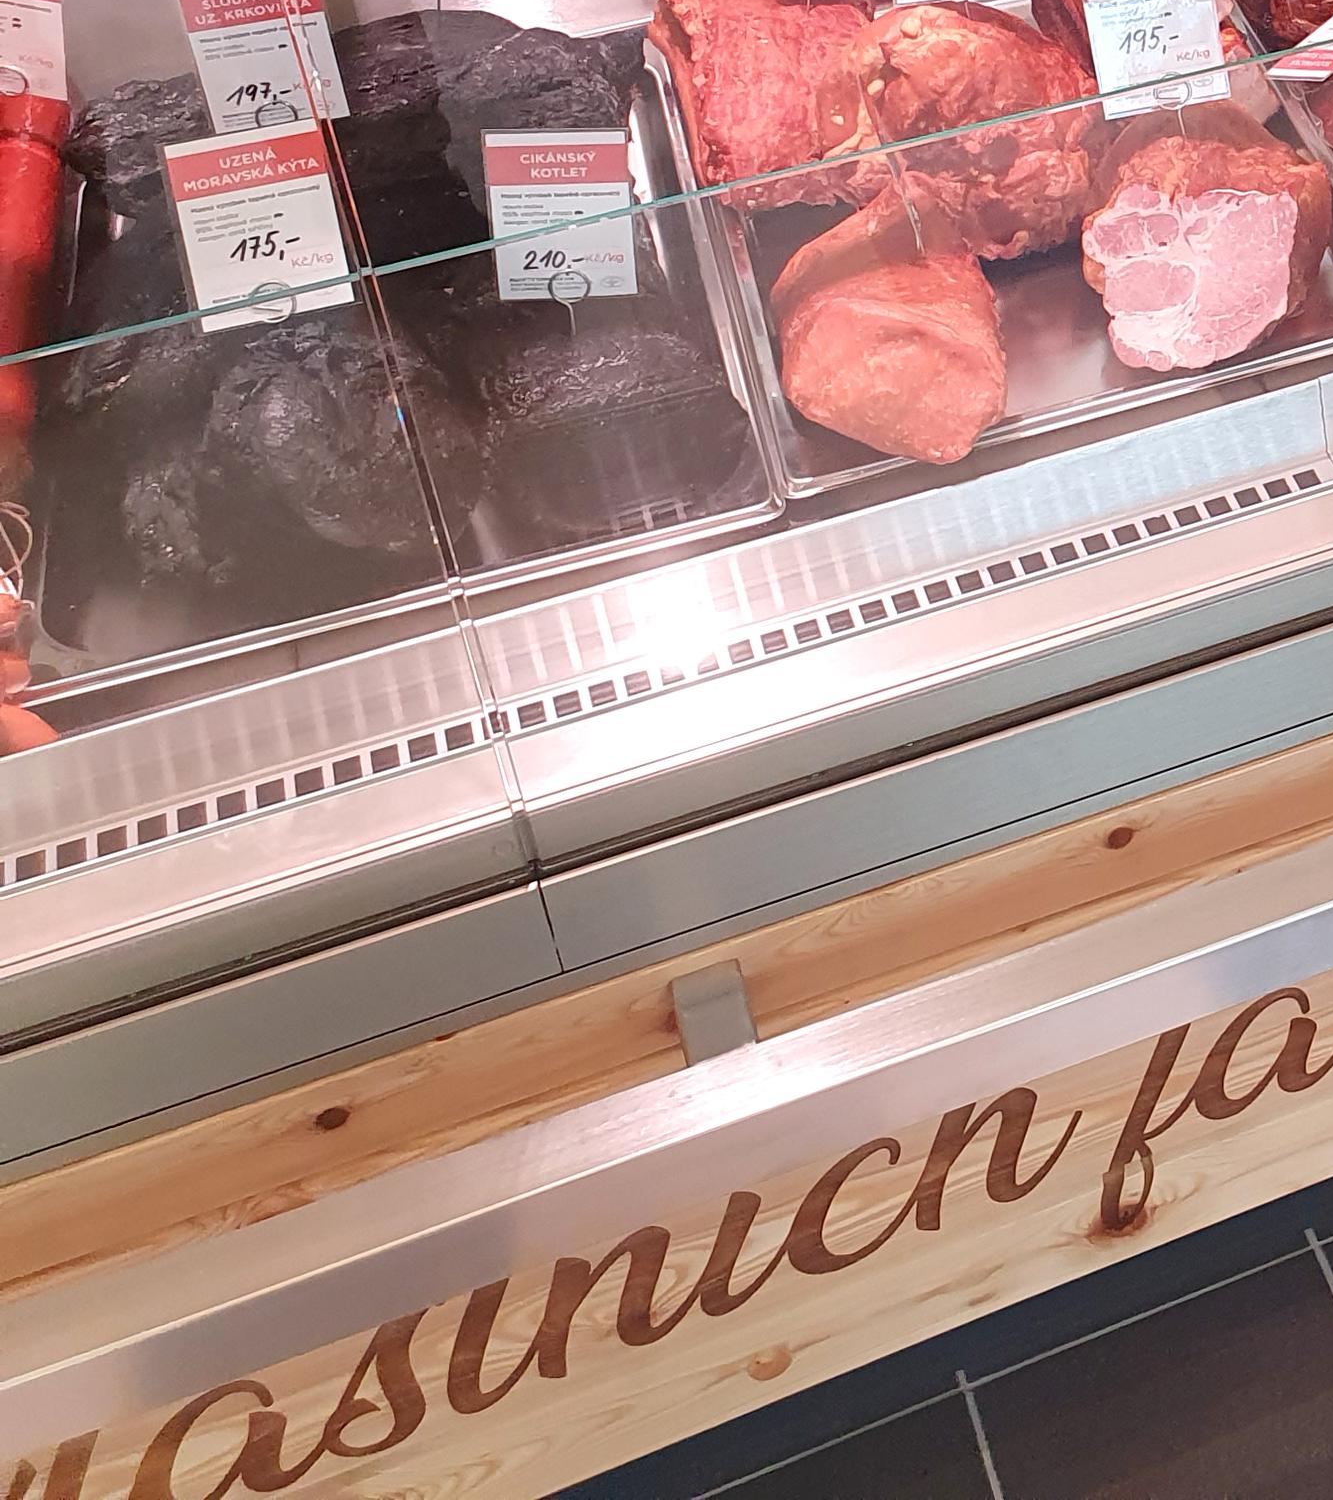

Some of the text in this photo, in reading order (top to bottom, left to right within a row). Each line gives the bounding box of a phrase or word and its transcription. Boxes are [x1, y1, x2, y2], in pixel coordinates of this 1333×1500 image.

[194, 12, 221, 26] UZ.
[1119, 25, 1180, 54] 195,-
[227, 81, 292, 106] 197,-
[219, 146, 278, 169] UZENÁ
[520, 150, 597, 165] CIKÁNSKÝ
[183, 157, 320, 192] MORAVSKÁ KÝTA
[530, 167, 589, 179] KOTLET
[230, 230, 301, 262] 175,-
[291, 253, 335, 268] Kč/kg
